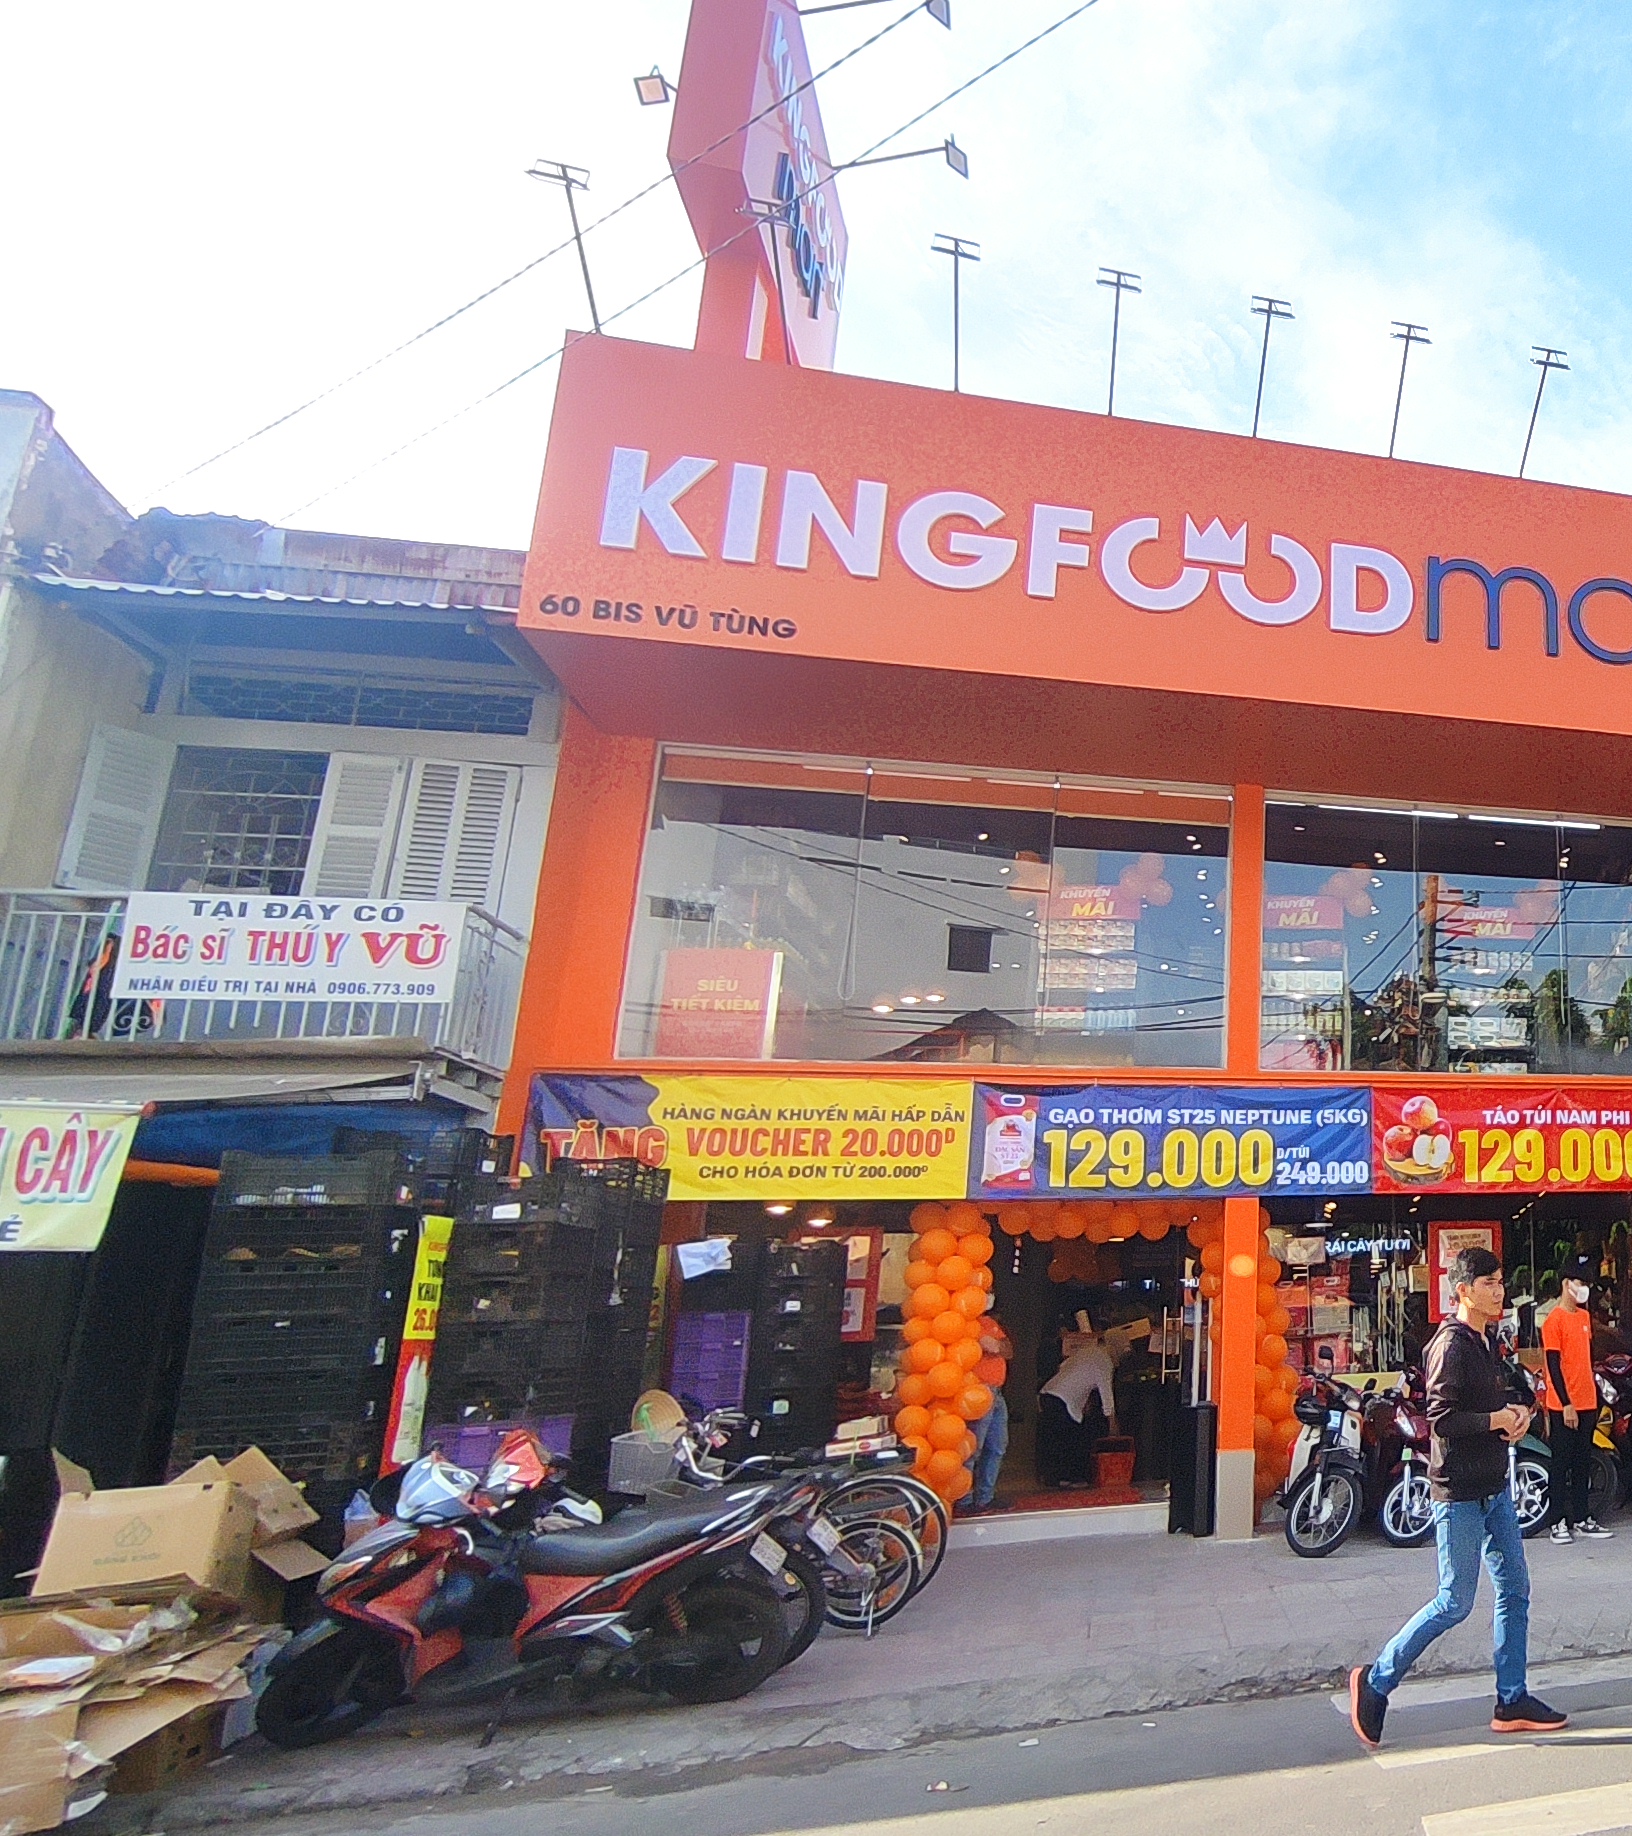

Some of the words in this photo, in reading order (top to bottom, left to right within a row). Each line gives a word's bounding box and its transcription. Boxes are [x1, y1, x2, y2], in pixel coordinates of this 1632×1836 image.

[539, 594, 581, 617] 60
[592, 599, 643, 623] BIS
[654, 604, 698, 629] VŨ
[709, 607, 797, 638] TÙNG
[1060, 887, 1111, 899] KHUYẾN
[188, 900, 248, 922] TẠI
[263, 899, 345, 921] ĐÂY
[354, 901, 405, 923] CÓ
[1072, 898, 1115, 917] MÃI
[1278, 907, 1320, 926] MÃI
[130, 924, 192, 962] Bác
[200, 928, 232, 962] sĩ
[361, 923, 451, 968] VŨ
[128, 977, 174, 996] NHẬN
[223, 979, 248, 996] TRỊ
[255, 980, 278, 997] TẠI
[284, 976, 317, 994] NHÀ
[327, 981, 436, 997] 0906.773.909
[697, 976, 738, 992] SIÊU
[662, 1103, 716, 1121] HÀNG
[720, 1104, 772, 1121] NGÀN
[777, 1103, 848, 1121] KHUYẾN
[853, 1106, 886, 1122] MÃI
[891, 1104, 926, 1122] HẤP
[931, 1102, 965, 1122] DẪN
[1048, 1107, 1094, 1129] GẠO
[1099, 1106, 1162, 1125] THƠM
[1167, 1108, 1216, 1125] ST25
[1221, 1108, 1312, 1126] NEPTUNE
[1316, 1107, 1368, 1127] (5KG)
[1482, 1105, 1519, 1125] TÁO
[1523, 1105, 1551, 1125] TÚI
[1556, 1109, 1597, 1124] NAM
[1601, 1109, 1630, 1125] PHI
[686, 1127, 832, 1158] VOUCHER
[15, 1112, 116, 1197] CÂY
[1042, 1128, 1274, 1189] 129.000
[699, 1165, 738, 1179] CHO
[744, 1161, 784, 1179] HÓA
[788, 1163, 827, 1179] ĐƠN
[832, 1161, 856, 1179] TỪ
[1275, 1160, 1370, 1186] 249.000
[1347, 1237, 1373, 1251] CÂY
